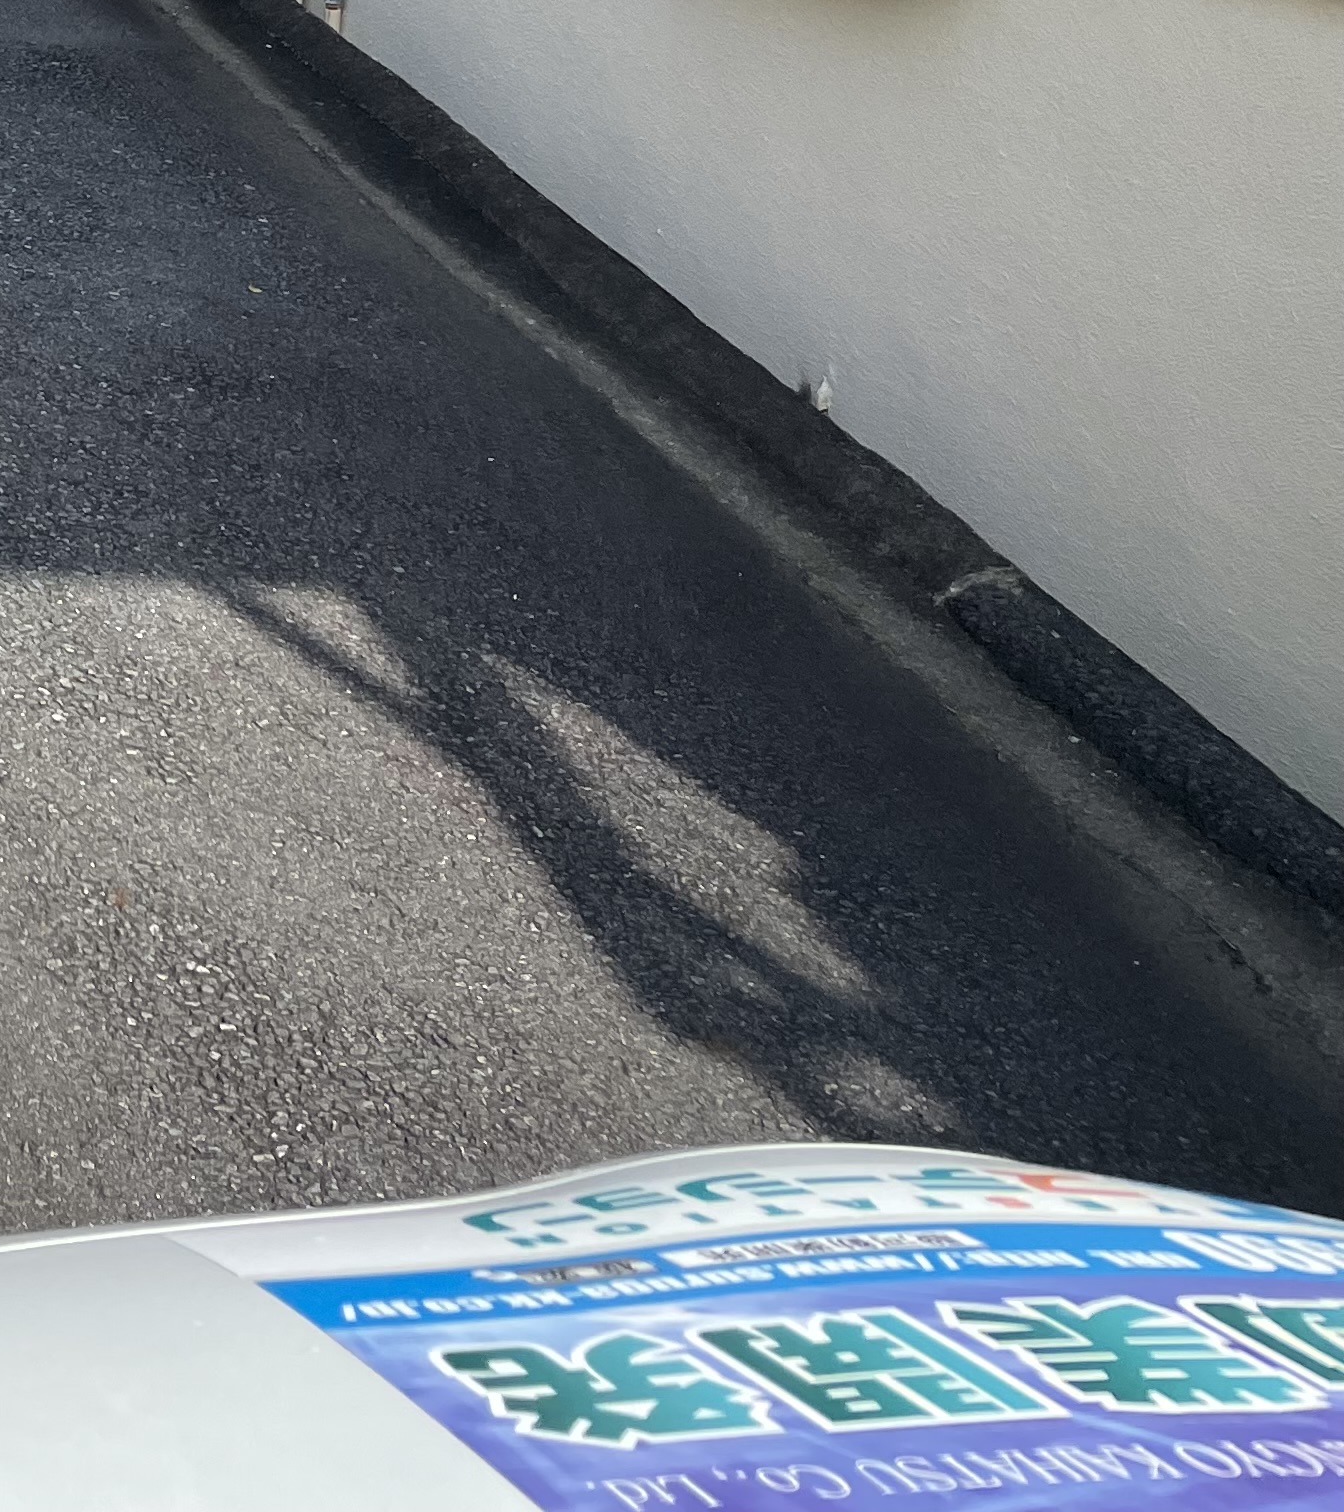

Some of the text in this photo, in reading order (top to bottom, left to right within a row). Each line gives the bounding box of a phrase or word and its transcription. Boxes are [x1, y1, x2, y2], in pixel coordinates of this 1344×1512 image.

[712, 1463, 852, 1499] Co.,
[856, 1442, 1188, 1495] KAIHATSU
[585, 1473, 723, 1512] Ltd.
